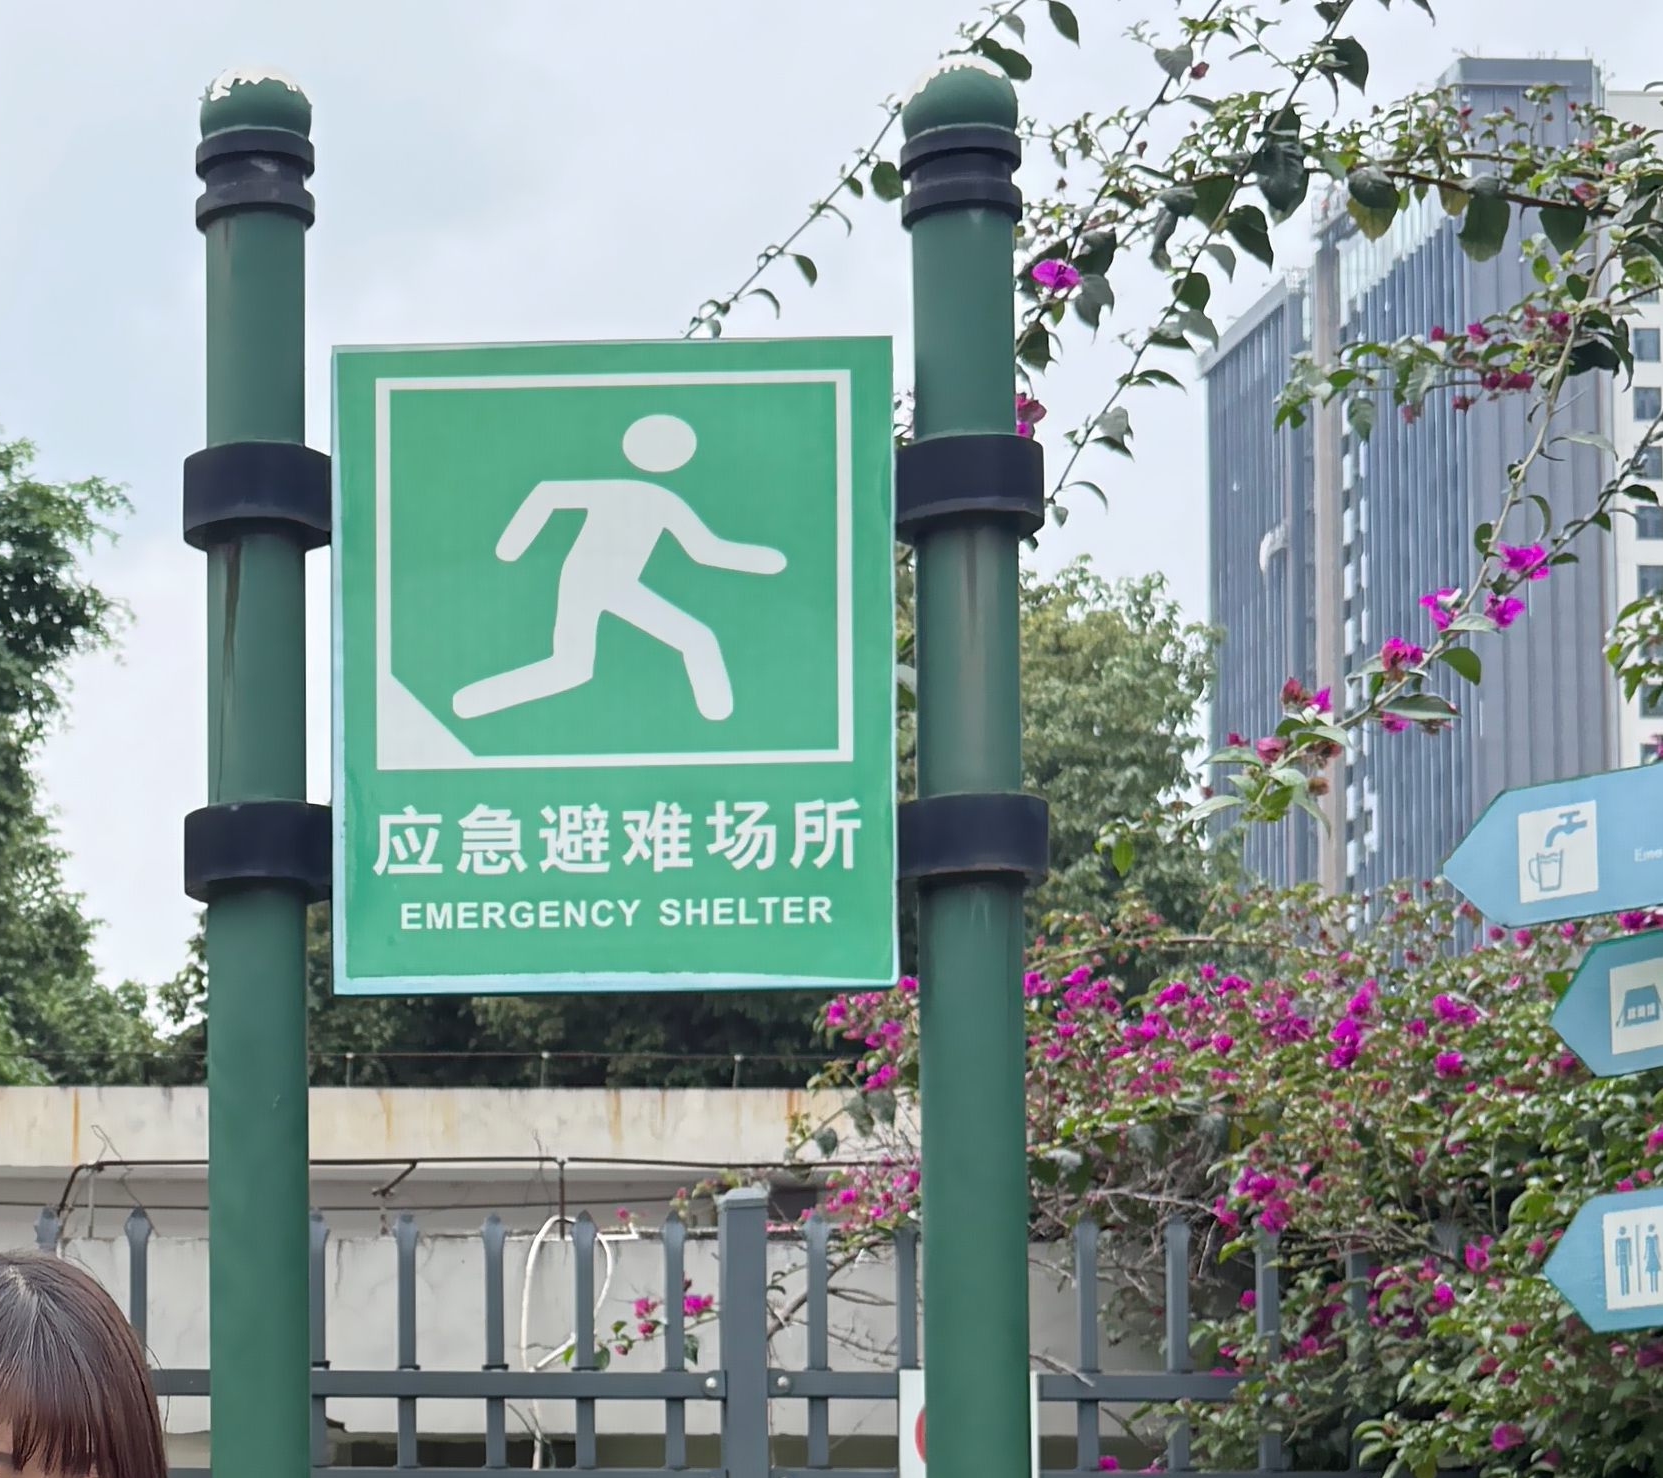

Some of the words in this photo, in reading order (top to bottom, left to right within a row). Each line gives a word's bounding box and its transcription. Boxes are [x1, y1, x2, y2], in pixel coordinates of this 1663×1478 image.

[373, 798, 862, 876] 应急避难场所
[400, 899, 641, 930] EMERGENCY
[659, 896, 833, 927] SHELTER
